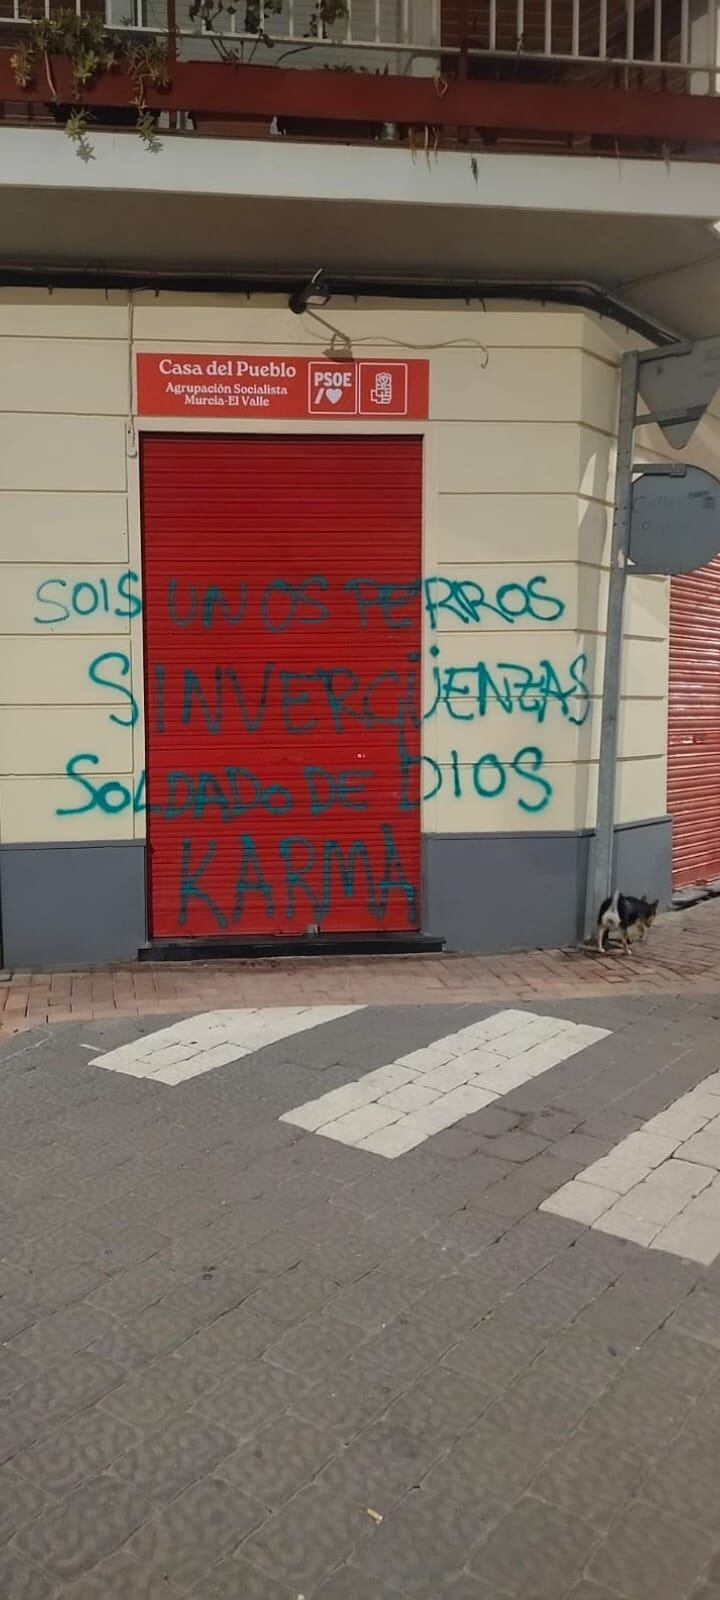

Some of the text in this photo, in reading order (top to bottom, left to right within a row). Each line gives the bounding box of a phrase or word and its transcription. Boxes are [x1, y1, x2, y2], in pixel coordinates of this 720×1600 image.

[159, 359, 297, 378] Casa del Pueblo
[165, 382, 288, 395] Agrupación Socialista
[313, 372, 352, 388] PSOE
[184, 395, 270, 407] Murcia-El Valle
[33, 570, 143, 624] SOIS
[343, 575, 565, 630] PERROS
[307, 766, 372, 812] DE
[398, 742, 553, 813] DIOS
[177, 823, 417, 930] KARMA
